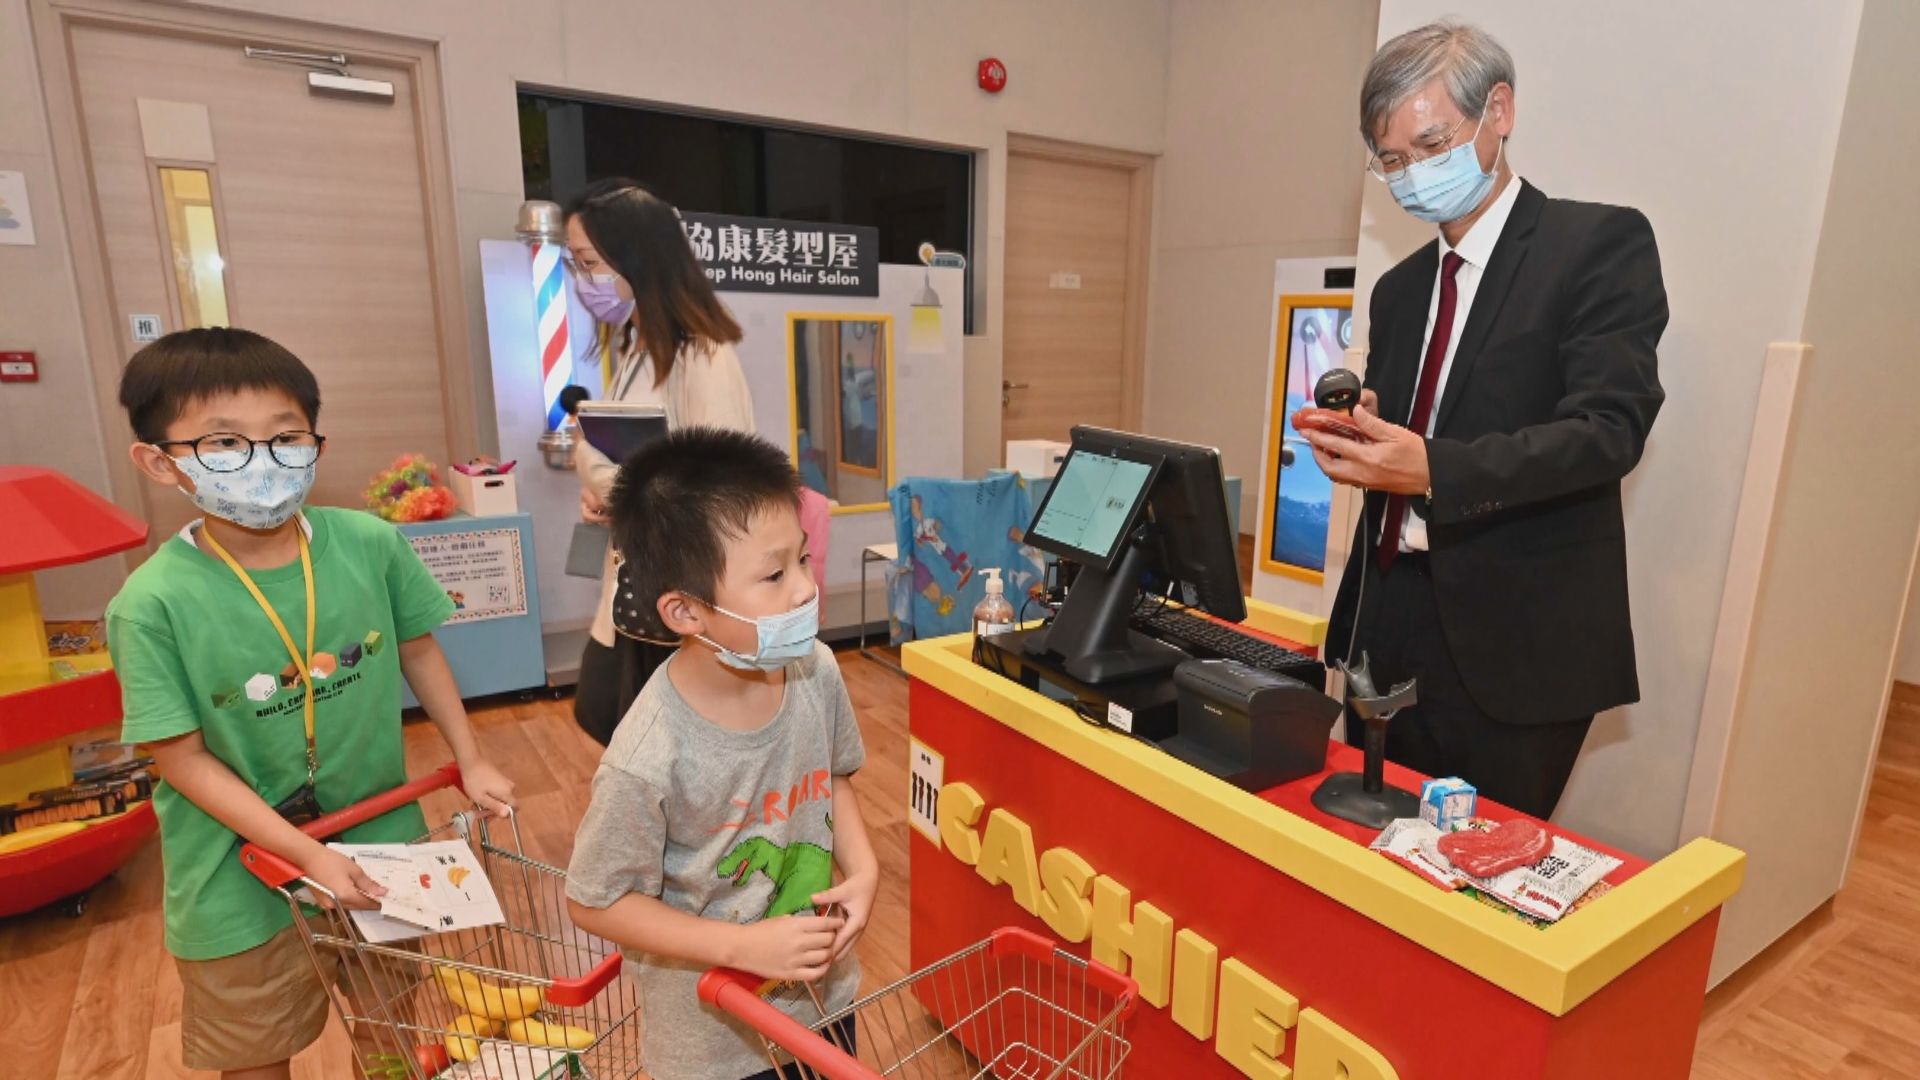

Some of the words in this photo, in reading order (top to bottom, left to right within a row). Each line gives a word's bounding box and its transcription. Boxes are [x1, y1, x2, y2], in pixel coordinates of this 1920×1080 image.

[731, 265, 776, 286] Hong
[780, 268, 814, 284] Hair
[817, 270, 860, 286] Salon
